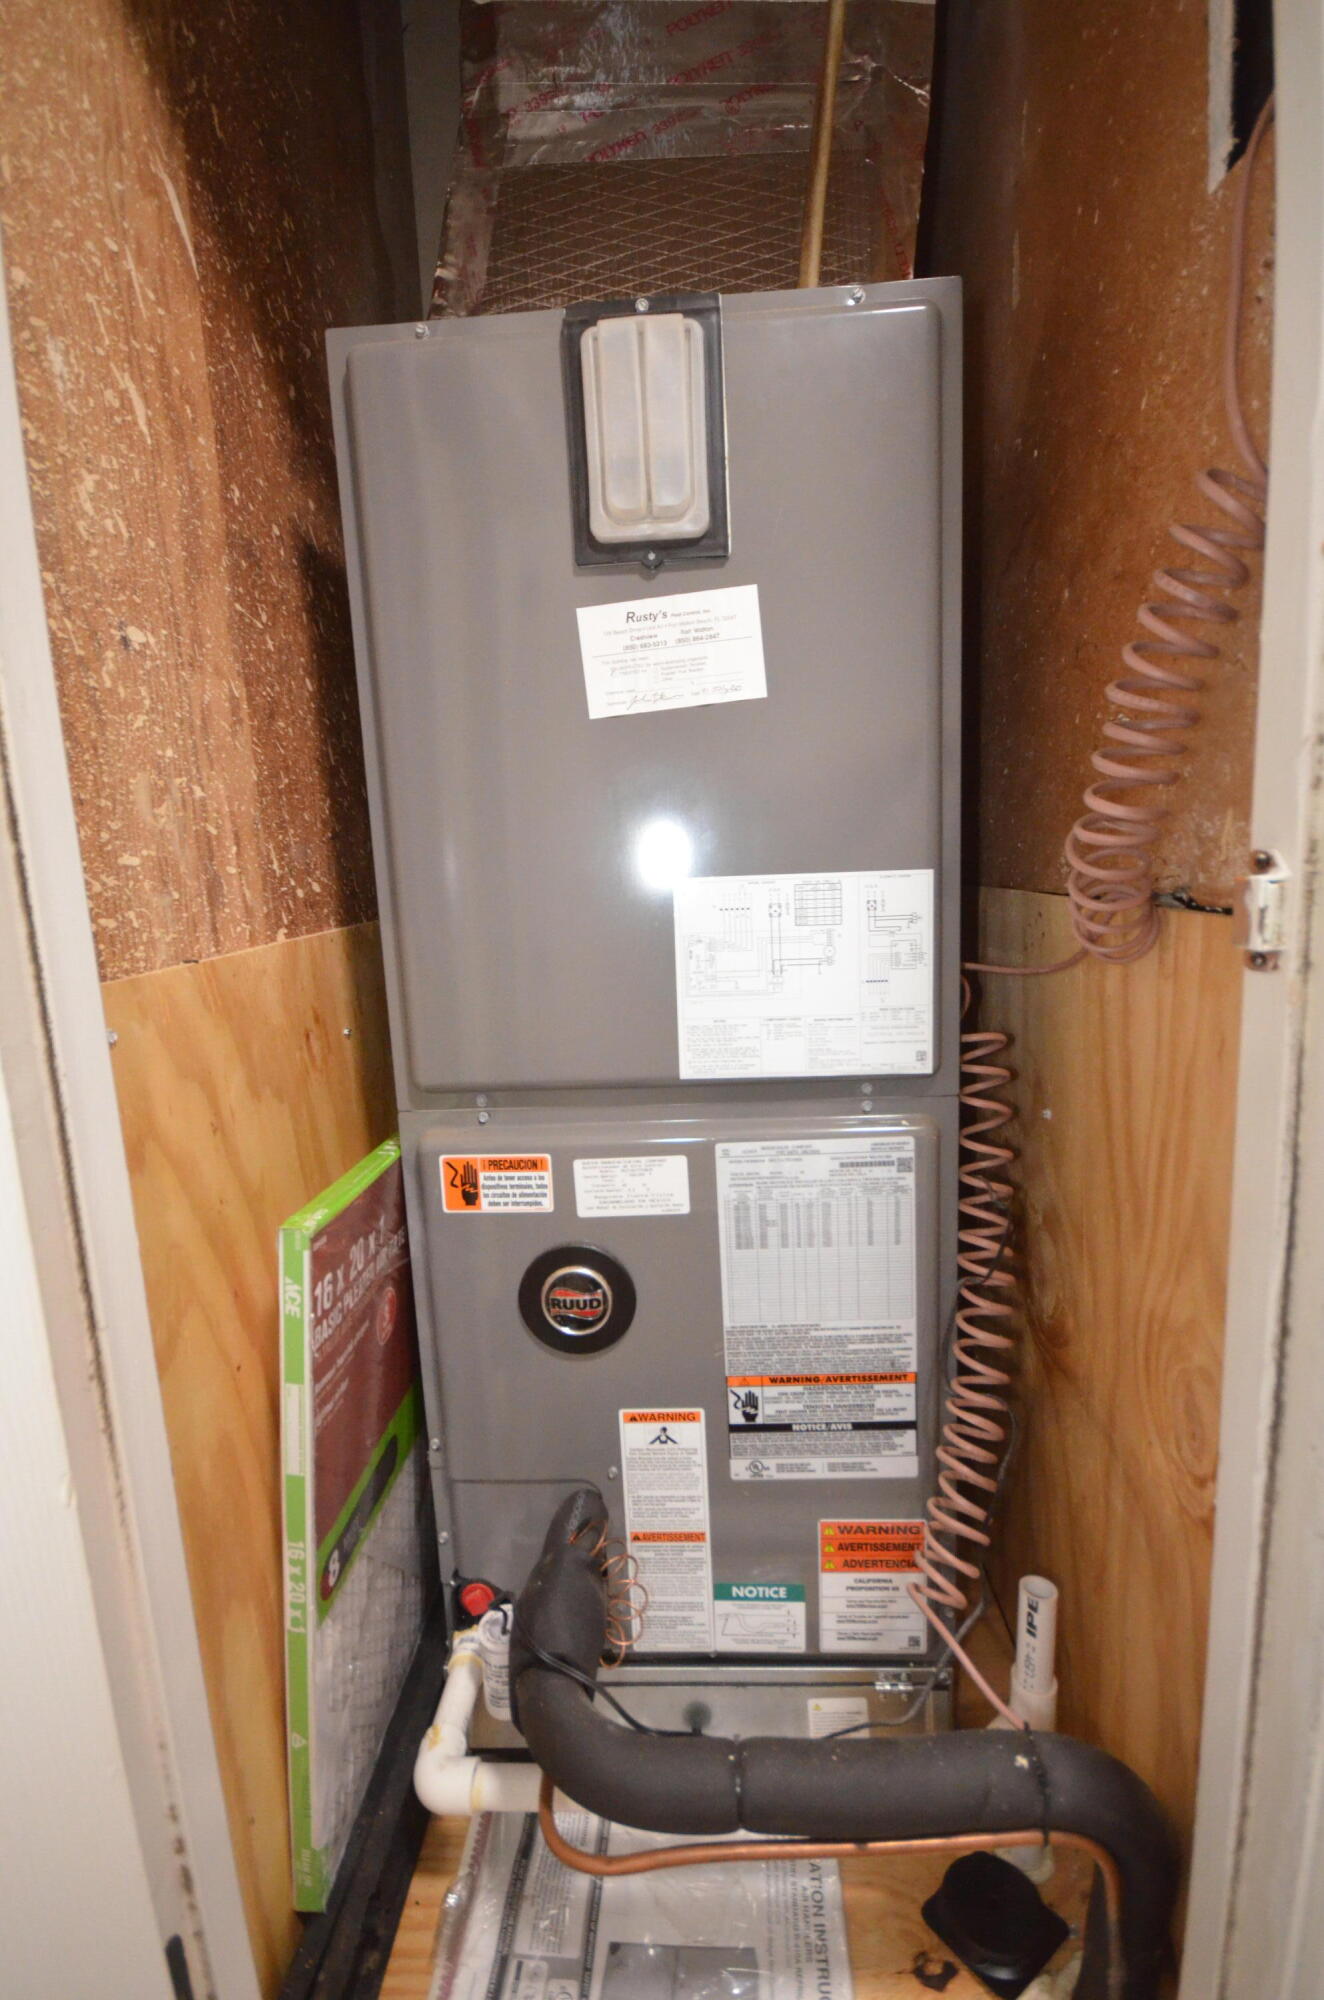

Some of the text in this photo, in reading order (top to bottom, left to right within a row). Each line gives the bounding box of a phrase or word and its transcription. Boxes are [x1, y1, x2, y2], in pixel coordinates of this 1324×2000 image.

[625, 609, 668, 624] Rusty's
[488, 1159, 538, 1170] PRECAUCION
[284, 1276, 302, 1318] ACE
[551, 1298, 602, 1310] RUUD
[639, 1413, 696, 1422] WARNING
[837, 1526, 921, 1535] WARNING
[288, 1542, 305, 1559] 16
[837, 1542, 920, 1552] AVERTISSEMENT
[843, 1560, 919, 1568] ADVERTENCIA
[732, 1586, 788, 1598] NOTICE
